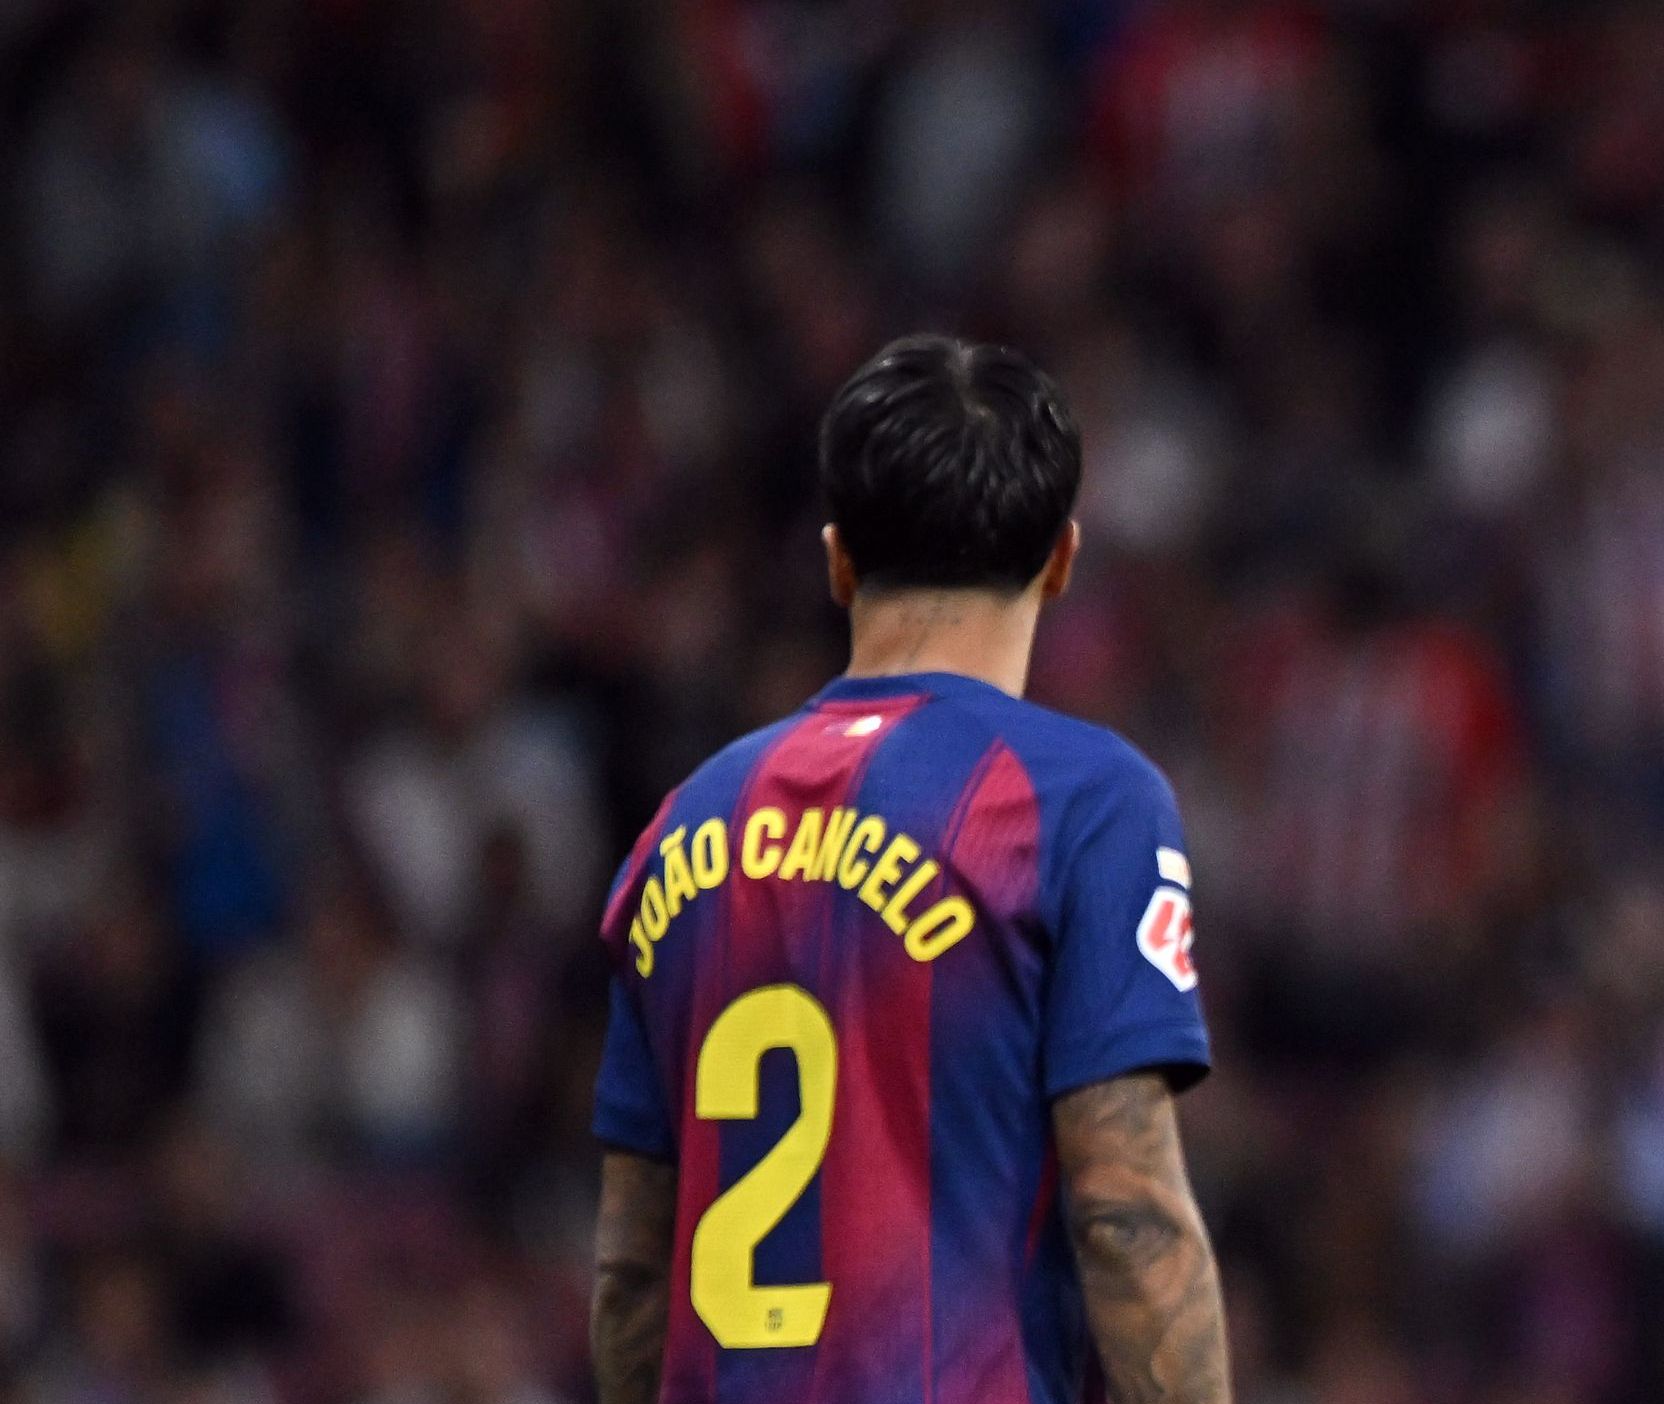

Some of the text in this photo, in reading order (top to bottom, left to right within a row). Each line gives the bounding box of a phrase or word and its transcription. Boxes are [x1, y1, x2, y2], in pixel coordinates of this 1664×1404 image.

[628, 818, 729, 979] JOÃO
[741, 806, 976, 963] CANCELO
[690, 982, 838, 1349] 2
